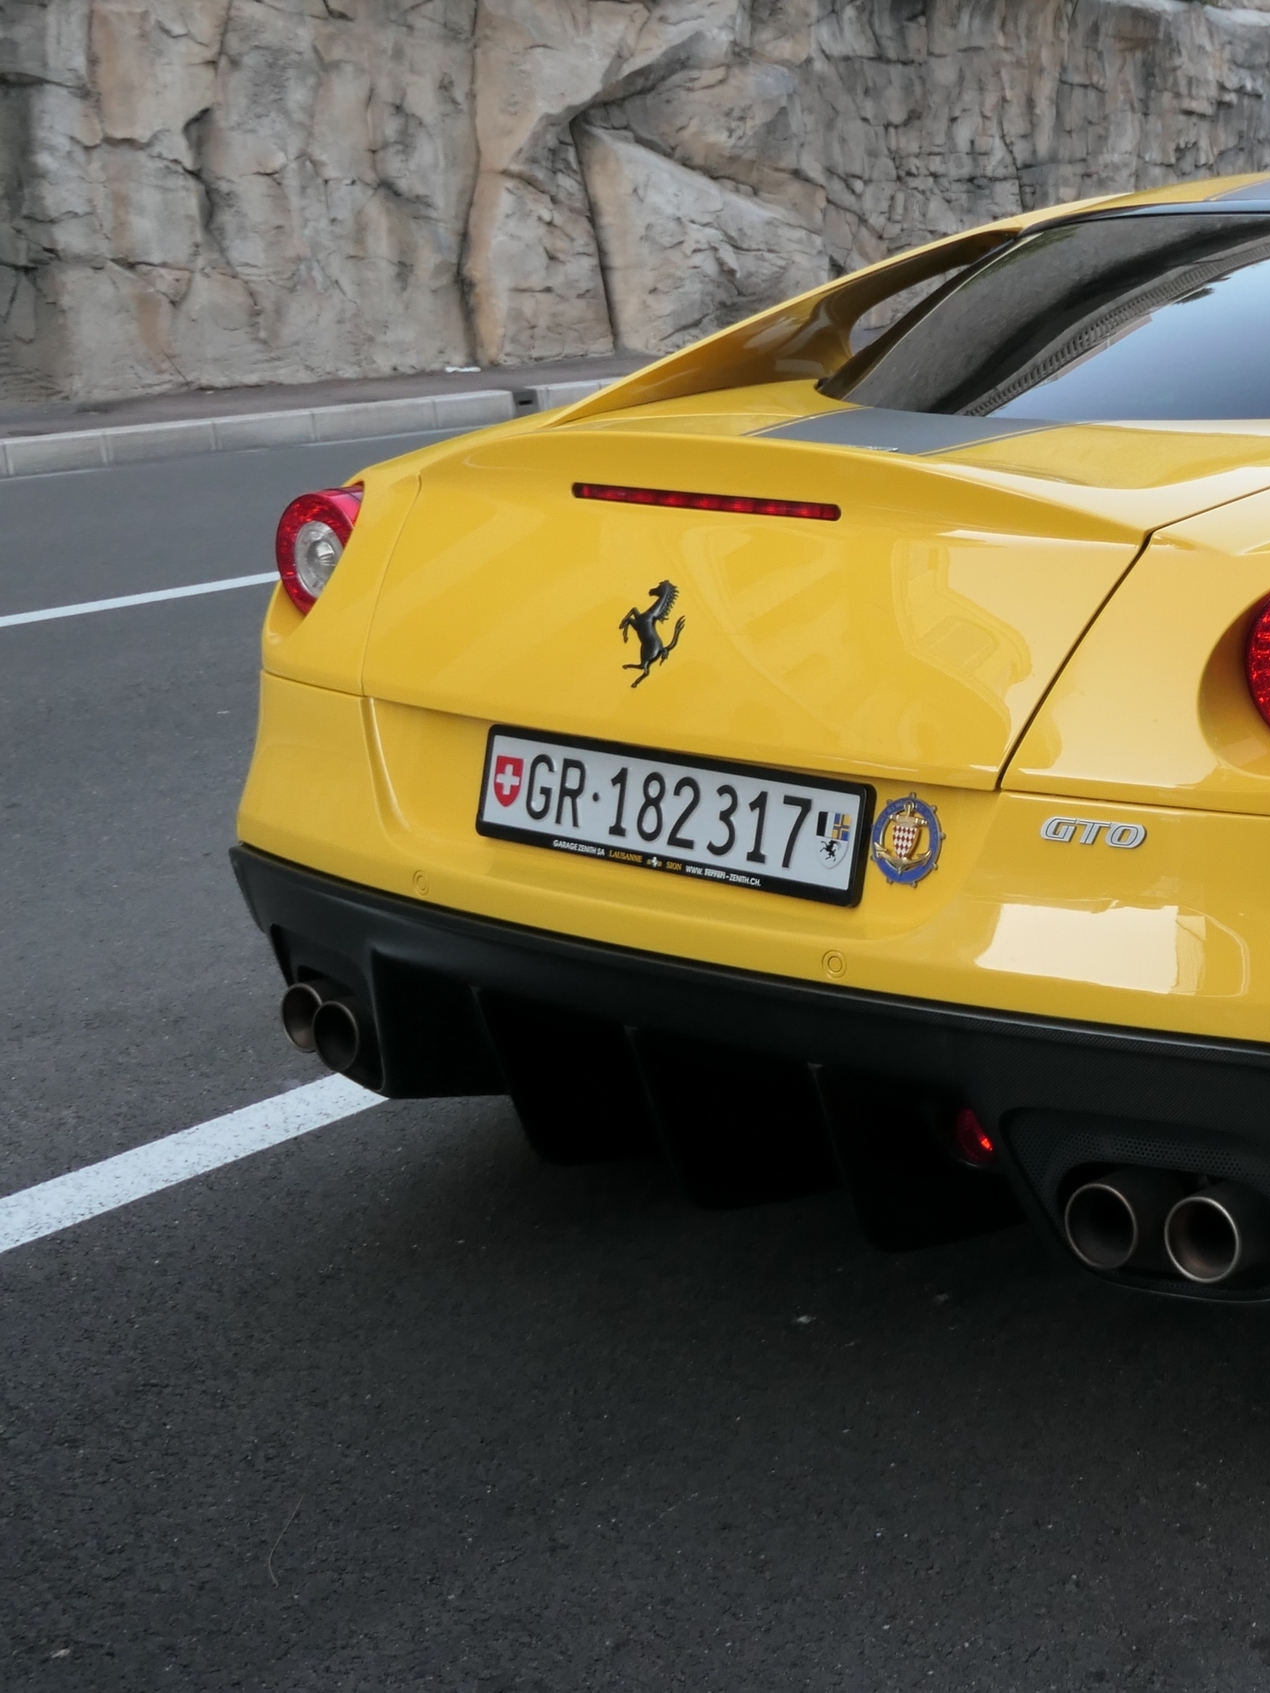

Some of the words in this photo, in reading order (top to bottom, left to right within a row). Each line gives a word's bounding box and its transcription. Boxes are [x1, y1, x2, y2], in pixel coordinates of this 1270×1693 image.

[1040, 815, 1146, 849] GTO
[553, 839, 578, 851] GARAGE
[578, 843, 597, 854] ZENITH
[597, 847, 605, 856] SA
[608, 849, 643, 863] LAUSANNE
[666, 861, 682, 871] SION
